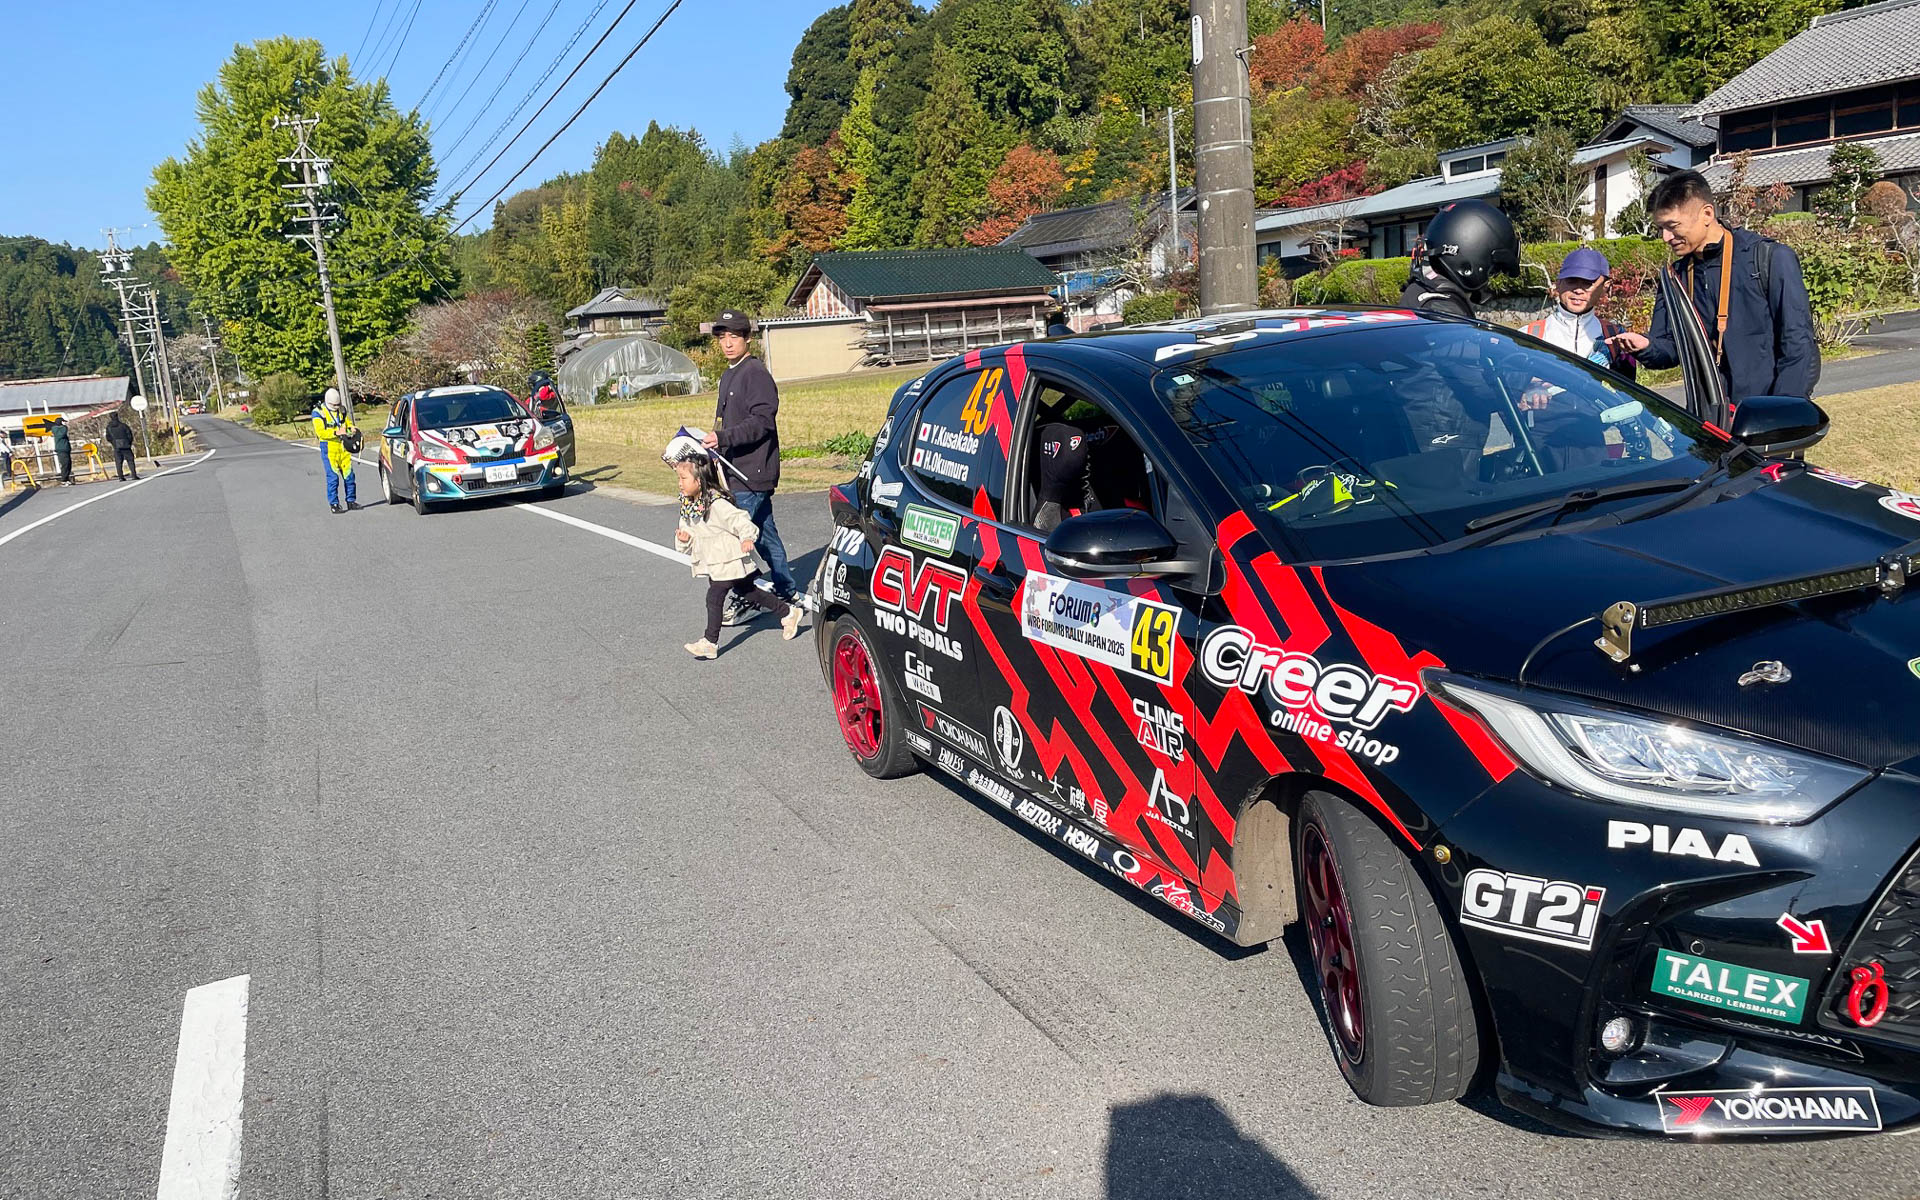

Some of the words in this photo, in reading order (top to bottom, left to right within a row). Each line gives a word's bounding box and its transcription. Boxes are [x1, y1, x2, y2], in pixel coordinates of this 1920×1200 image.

[960, 368, 1004, 435] 43
[931, 424, 979, 455] Y.Kusakabe
[923, 450, 969, 482] H.Okumura
[871, 546, 967, 631] CVT
[1048, 592, 1101, 628] FORUM8
[874, 608, 906, 636] TWO
[908, 621, 963, 662] PEDALS
[1027, 614, 1041, 631] WRC
[1041, 619, 1065, 637] FORUM8
[1065, 625, 1084, 643] RALLY
[1084, 633, 1107, 652] JAPAN
[1107, 639, 1125, 656] 2025
[1131, 607, 1174, 677] 43
[905, 651, 934, 682] Car
[1202, 626, 1419, 729] Creer
[936, 716, 988, 759] YOKOHAMA
[1137, 719, 1184, 761] AIR
[1271, 709, 1332, 741] online
[1335, 729, 1400, 765] shop
[1063, 825, 1100, 859] HOKA
[1608, 820, 1760, 867] PIAA
[1461, 869, 1605, 943] GT2i
[1665, 955, 1799, 1008] TALEX
[1667, 985, 1723, 1004] POLARIZED
[1727, 999, 1788, 1018] LENSMAKER
[1713, 1097, 1869, 1120] YOKOHAMA
